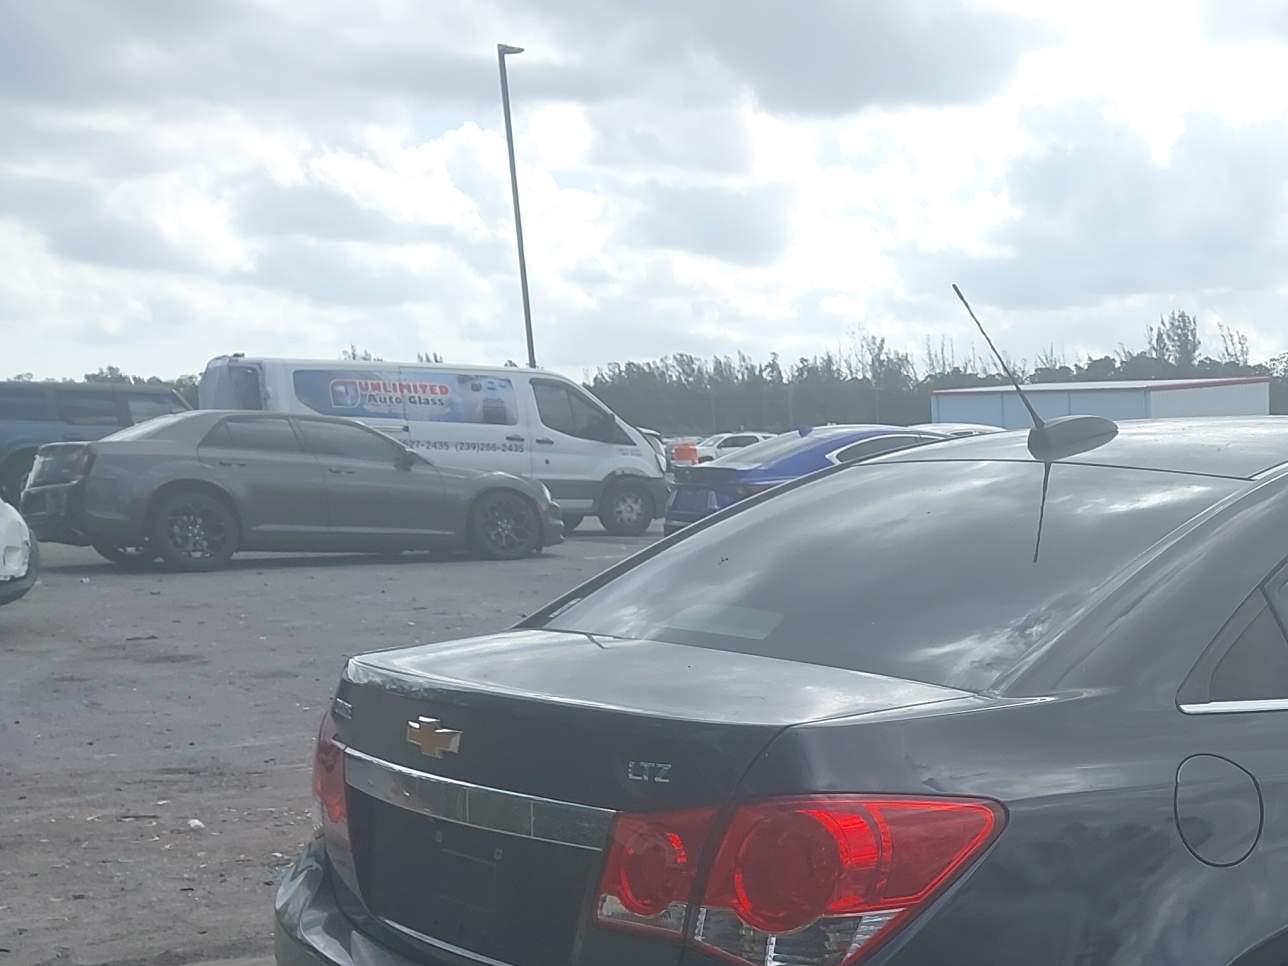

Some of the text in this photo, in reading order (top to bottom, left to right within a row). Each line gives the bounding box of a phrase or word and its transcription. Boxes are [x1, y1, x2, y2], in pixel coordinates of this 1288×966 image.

[357, 380, 449, 395] UNLIMITED
[367, 394, 445, 406] Auto Glass
[628, 761, 672, 782] LTZ
